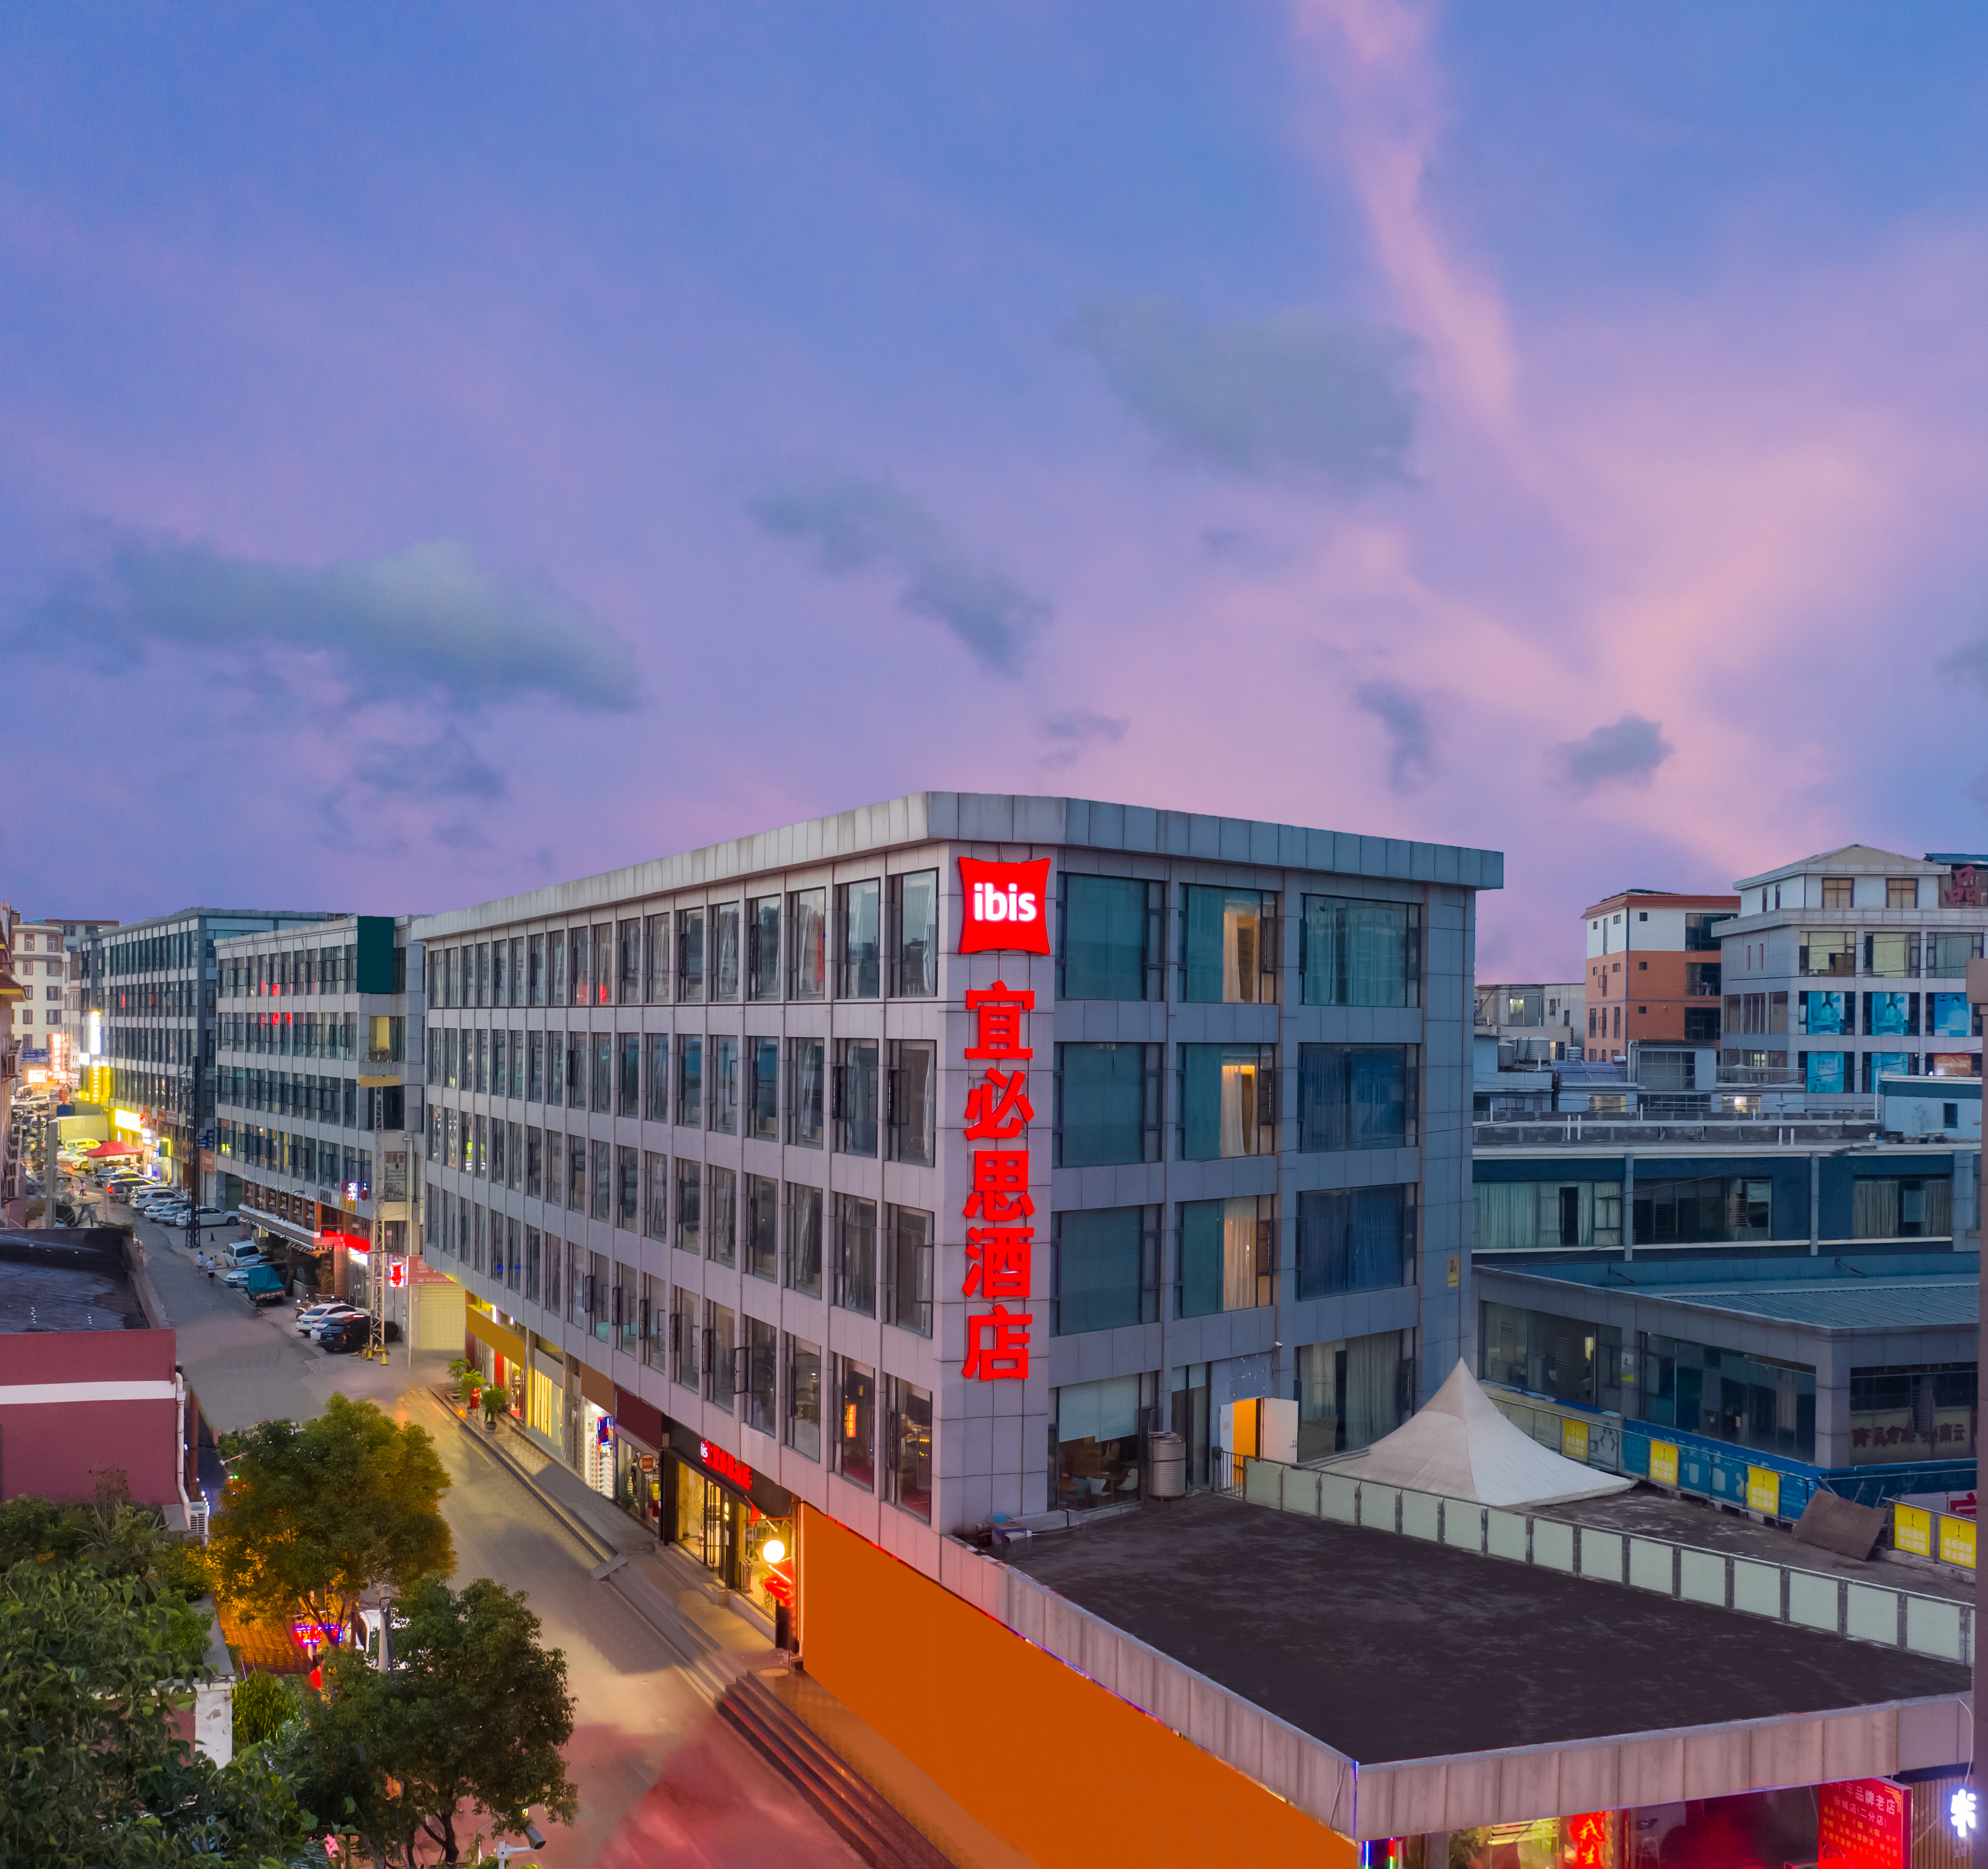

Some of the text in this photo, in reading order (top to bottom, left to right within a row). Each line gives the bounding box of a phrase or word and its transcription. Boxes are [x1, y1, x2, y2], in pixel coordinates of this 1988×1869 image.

[974, 883, 1036, 921] ibis
[962, 980, 1035, 1381] 宜必思酒店
